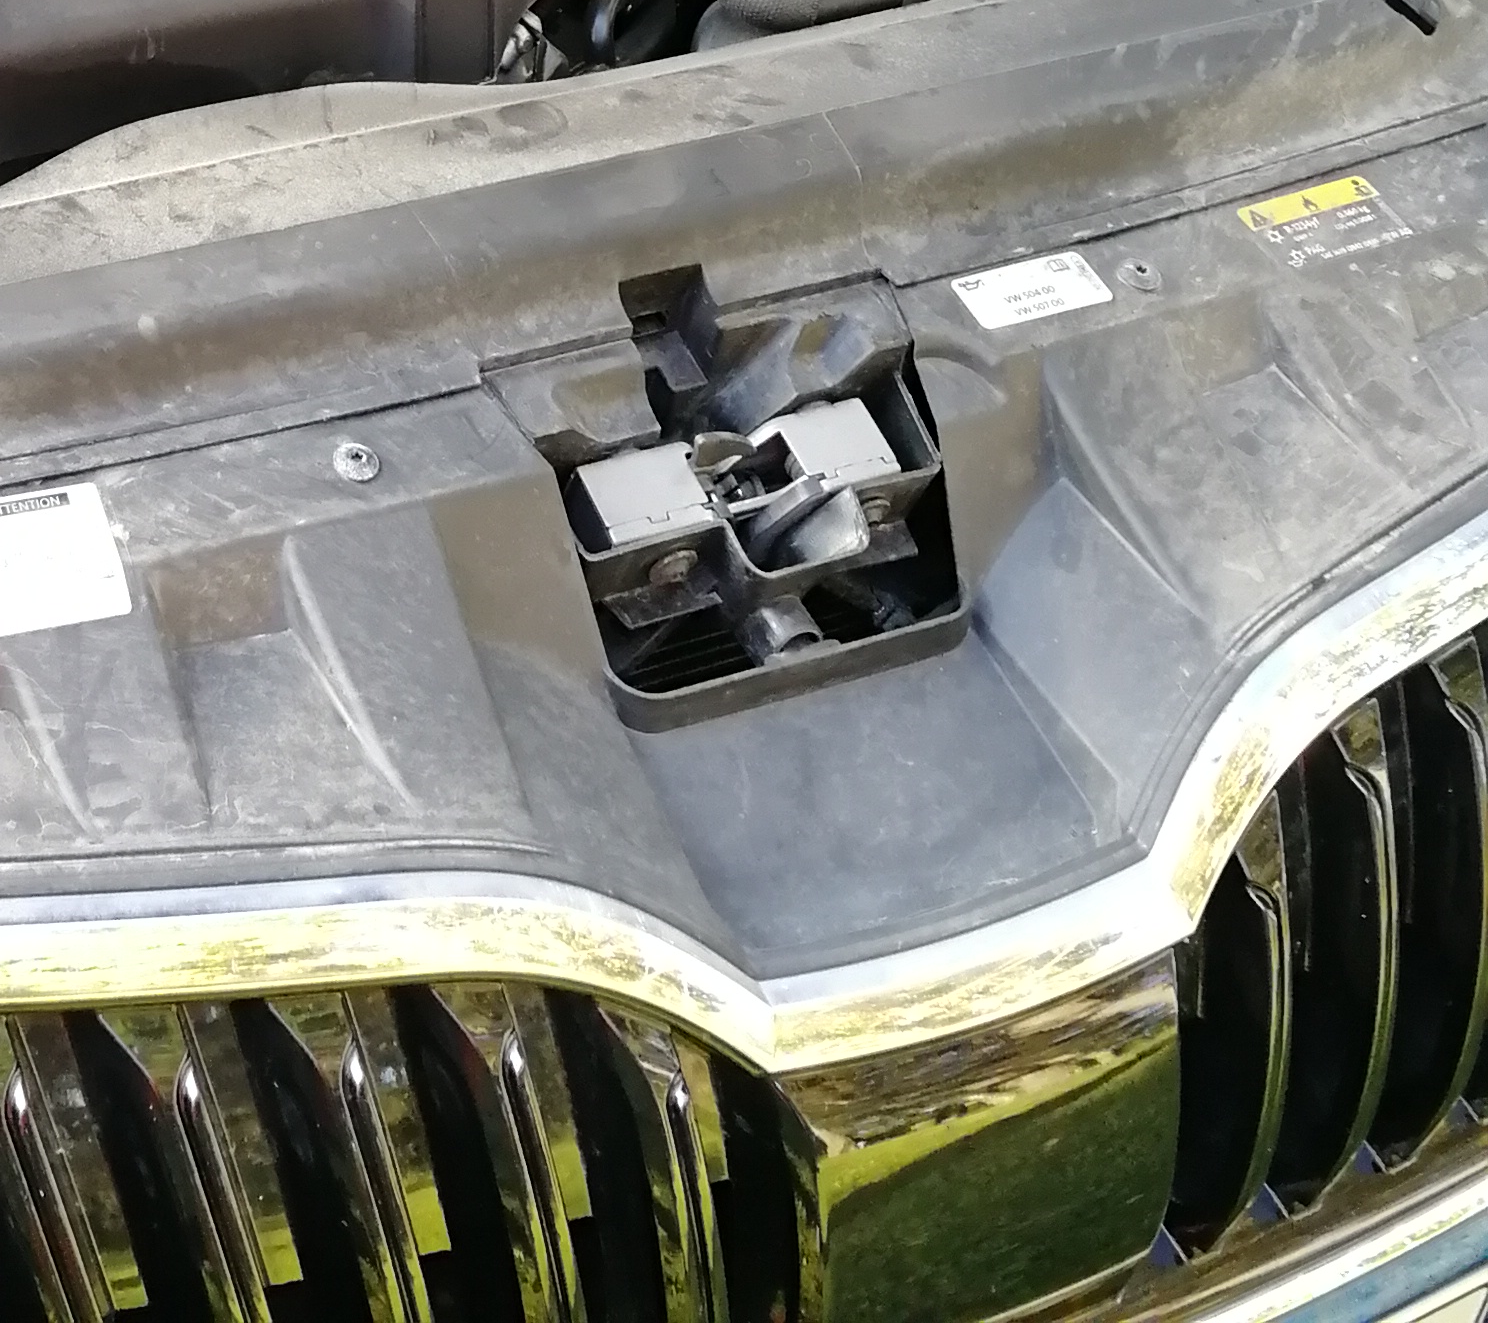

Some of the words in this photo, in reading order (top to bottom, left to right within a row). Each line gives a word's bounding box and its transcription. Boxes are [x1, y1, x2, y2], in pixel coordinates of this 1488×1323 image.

[1003, 293, 1023, 304] VW
[1023, 289, 1042, 300] 504
[1041, 285, 1056, 295] 00
[1014, 306, 1032, 316] VW
[1032, 301, 1050, 312] 507
[1050, 297, 1065, 307] 00
